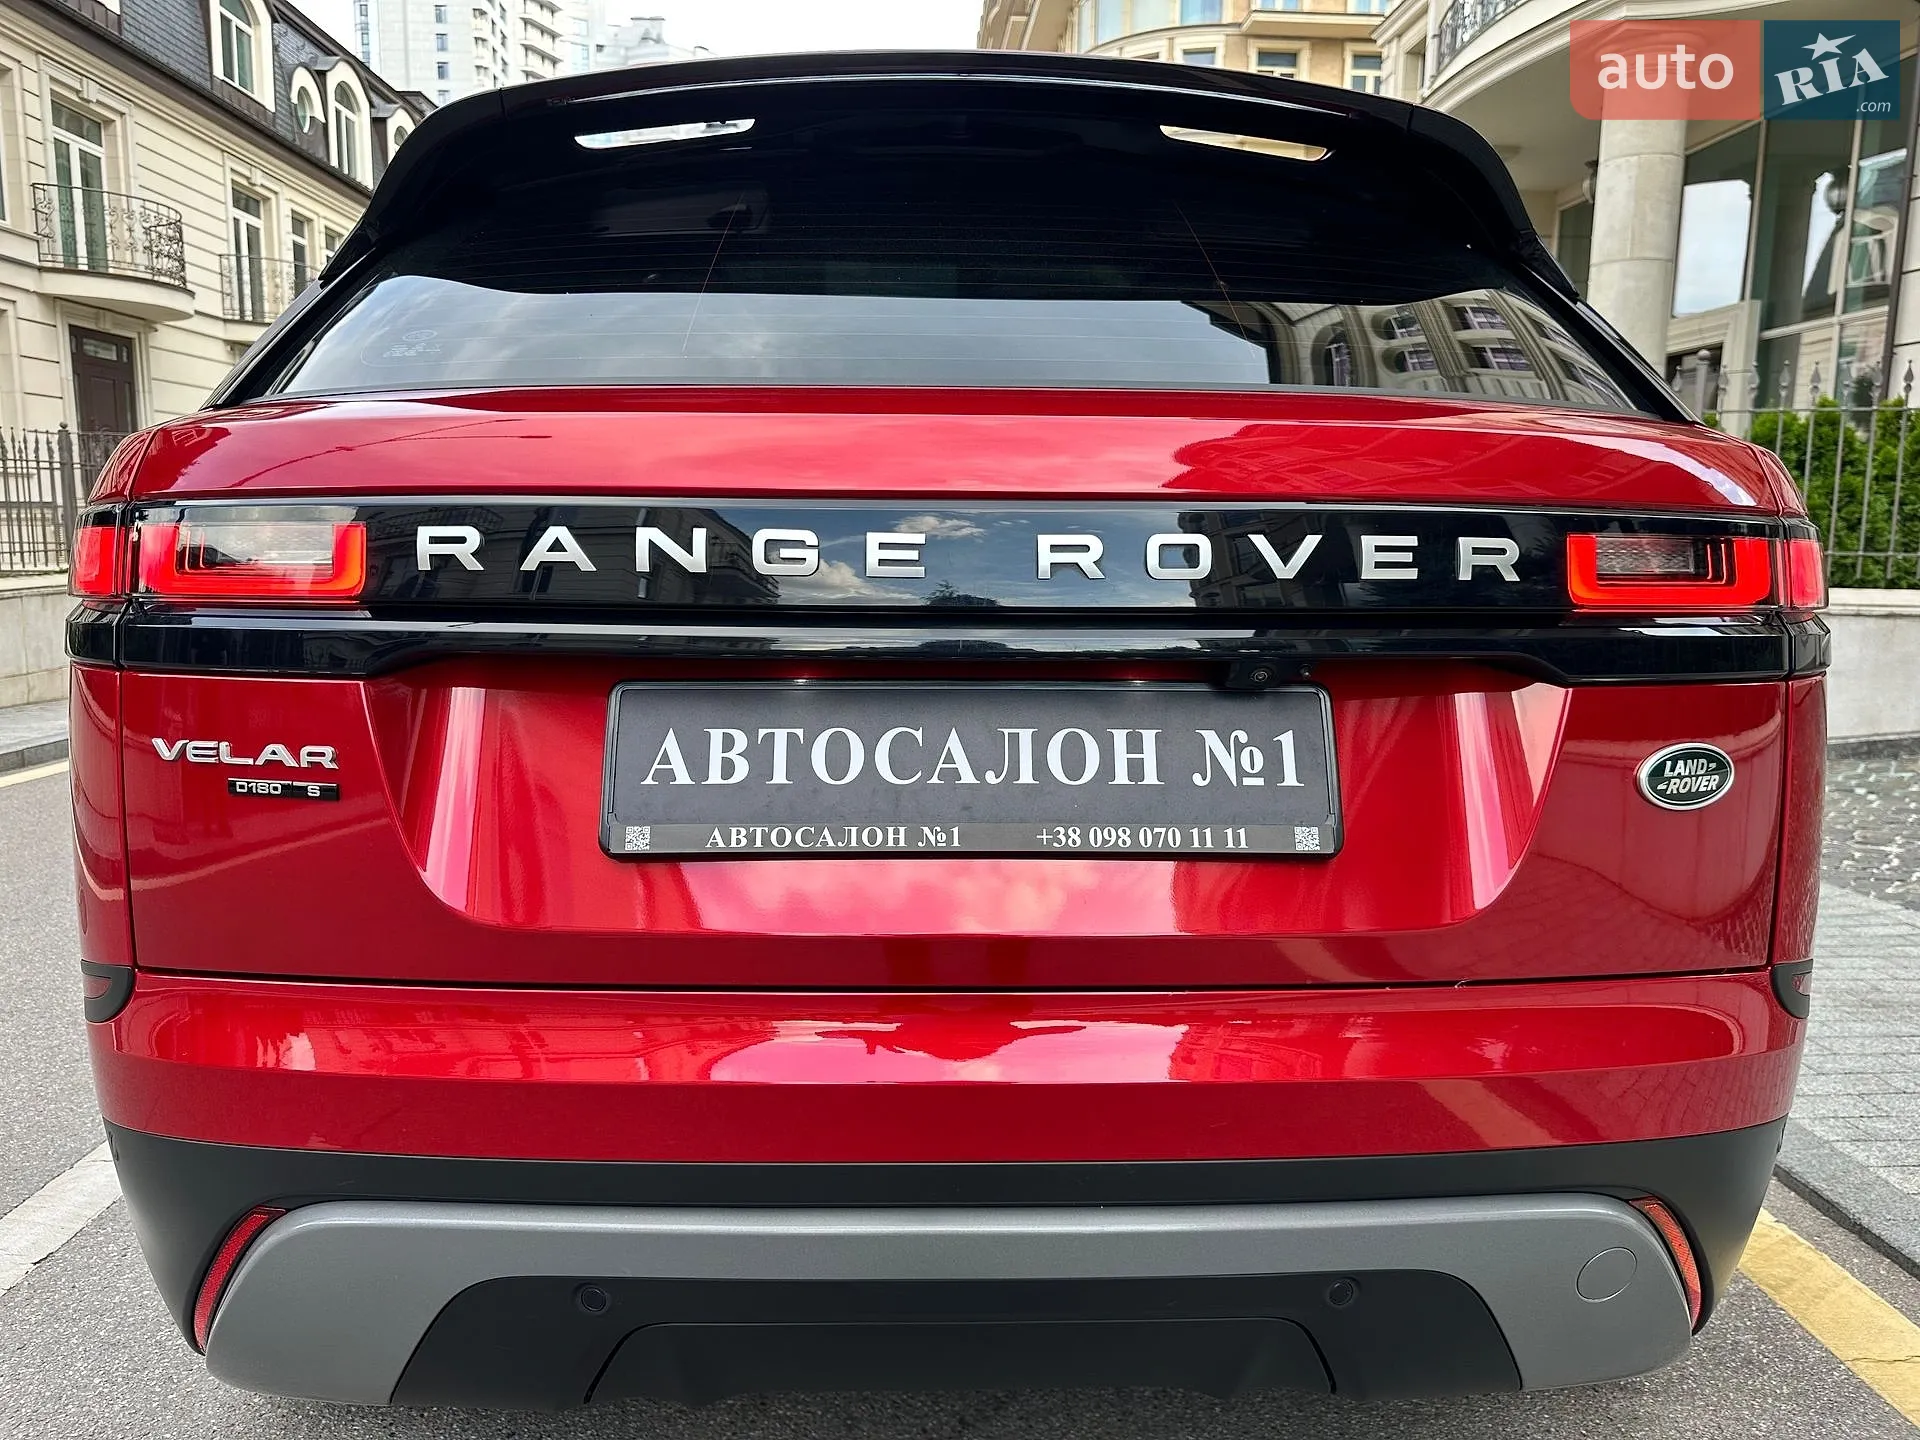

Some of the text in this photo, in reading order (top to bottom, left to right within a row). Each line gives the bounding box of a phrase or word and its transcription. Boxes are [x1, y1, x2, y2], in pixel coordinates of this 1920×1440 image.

[416, 525, 1521, 582] RANGE ROVER
[151, 737, 339, 770] VELAR
[640, 727, 1305, 787] АВТОСАЛОН №1
[1664, 758, 1708, 777] LAND
[235, 781, 321, 797] D180 S
[1666, 775, 1719, 794] ROVER
[705, 826, 961, 848] АВТОСАЛОН №1
[1036, 827, 1249, 848] +38 098 070 11 11
